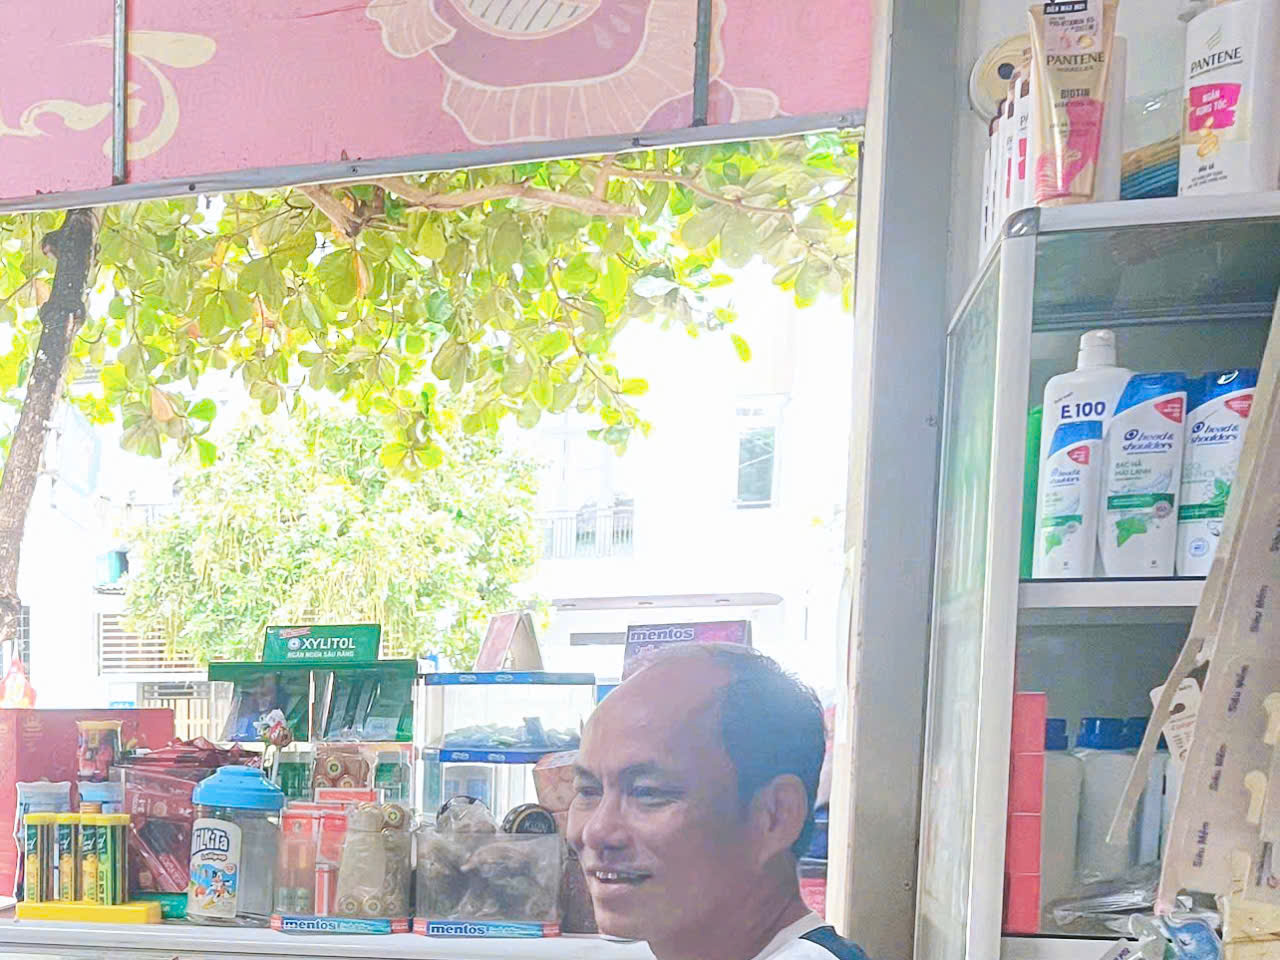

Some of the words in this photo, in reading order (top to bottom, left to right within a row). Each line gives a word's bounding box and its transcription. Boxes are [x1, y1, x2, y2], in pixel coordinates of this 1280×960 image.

[1046, 52, 1104, 66] PANTENE
[1190, 46, 1241, 73] PANTENE
[1060, 88, 1090, 99] BIOTIN
[1061, 404, 1072, 419] E
[1076, 402, 1106, 417] 100
[1122, 440, 1173, 452] shoulders
[629, 628, 694, 641] mentos
[301, 638, 355, 649] XYLITOL
[284, 919, 336, 930] mentos
[430, 924, 486, 935] mentos
